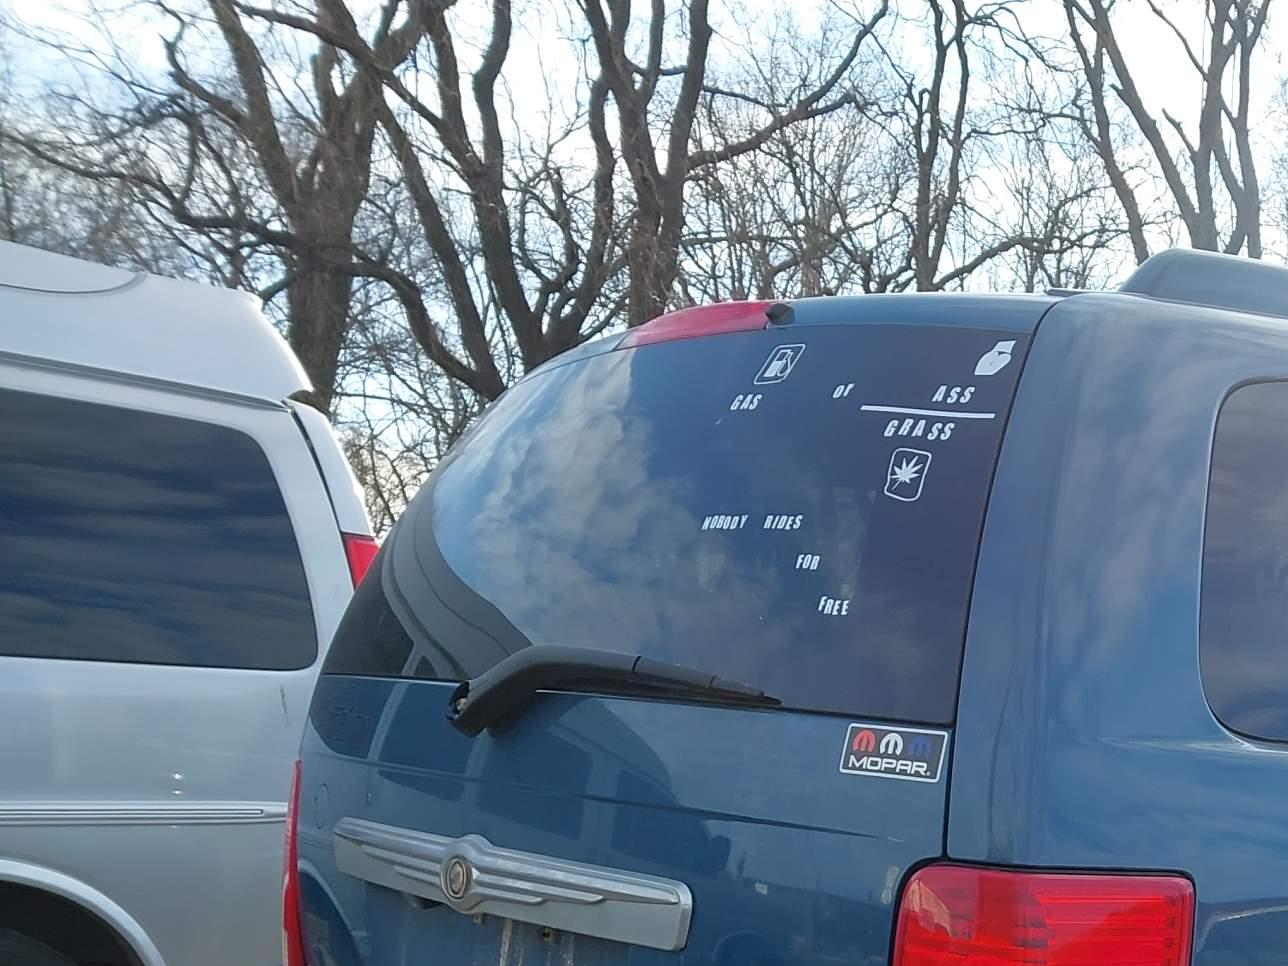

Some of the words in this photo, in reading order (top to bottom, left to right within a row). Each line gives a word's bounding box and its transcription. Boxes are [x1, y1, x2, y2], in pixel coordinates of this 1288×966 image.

[730, 393, 763, 411] GAS
[931, 385, 976, 404] ASS
[883, 418, 955, 441] GRASS
[701, 514, 749, 531] NOBODY
[763, 514, 803, 530] RIDES
[795, 553, 821, 571] FOR
[817, 595, 850, 616] FREE
